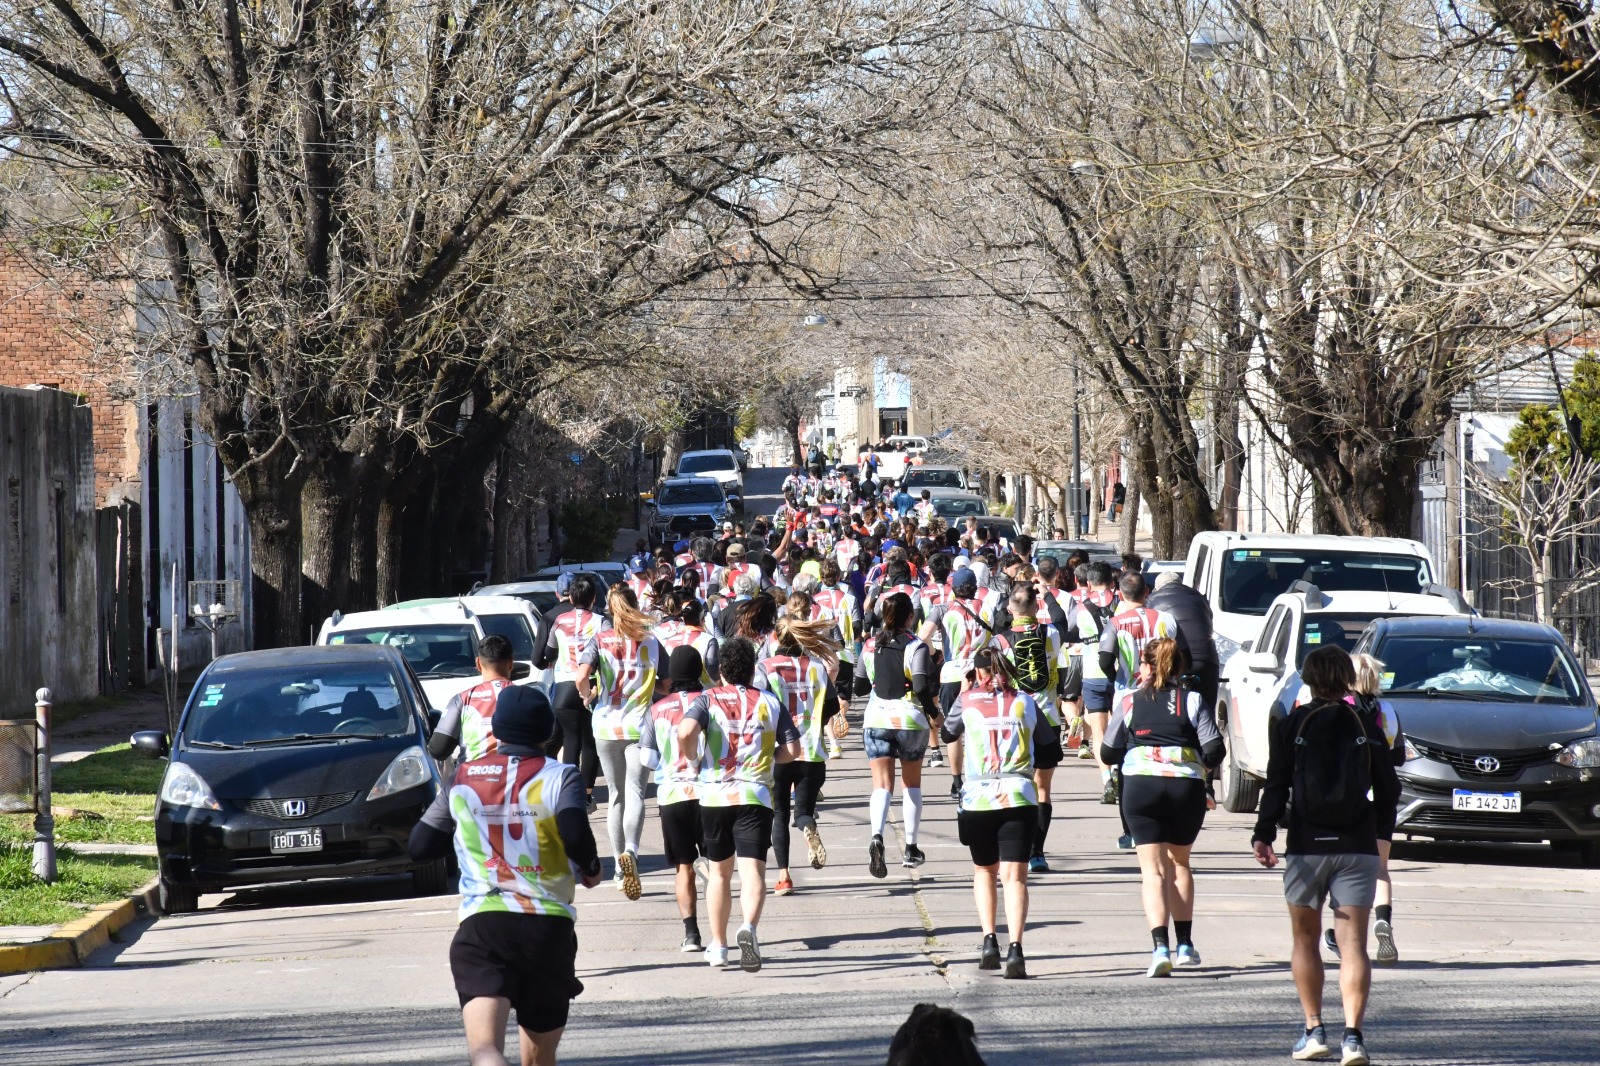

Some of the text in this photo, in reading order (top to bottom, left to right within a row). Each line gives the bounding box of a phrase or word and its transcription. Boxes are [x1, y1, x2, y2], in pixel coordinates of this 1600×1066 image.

[467, 764, 504, 776] CROSS
[1458, 796, 1517, 810] AF 142 JA
[274, 833, 321, 849] IBU 316
